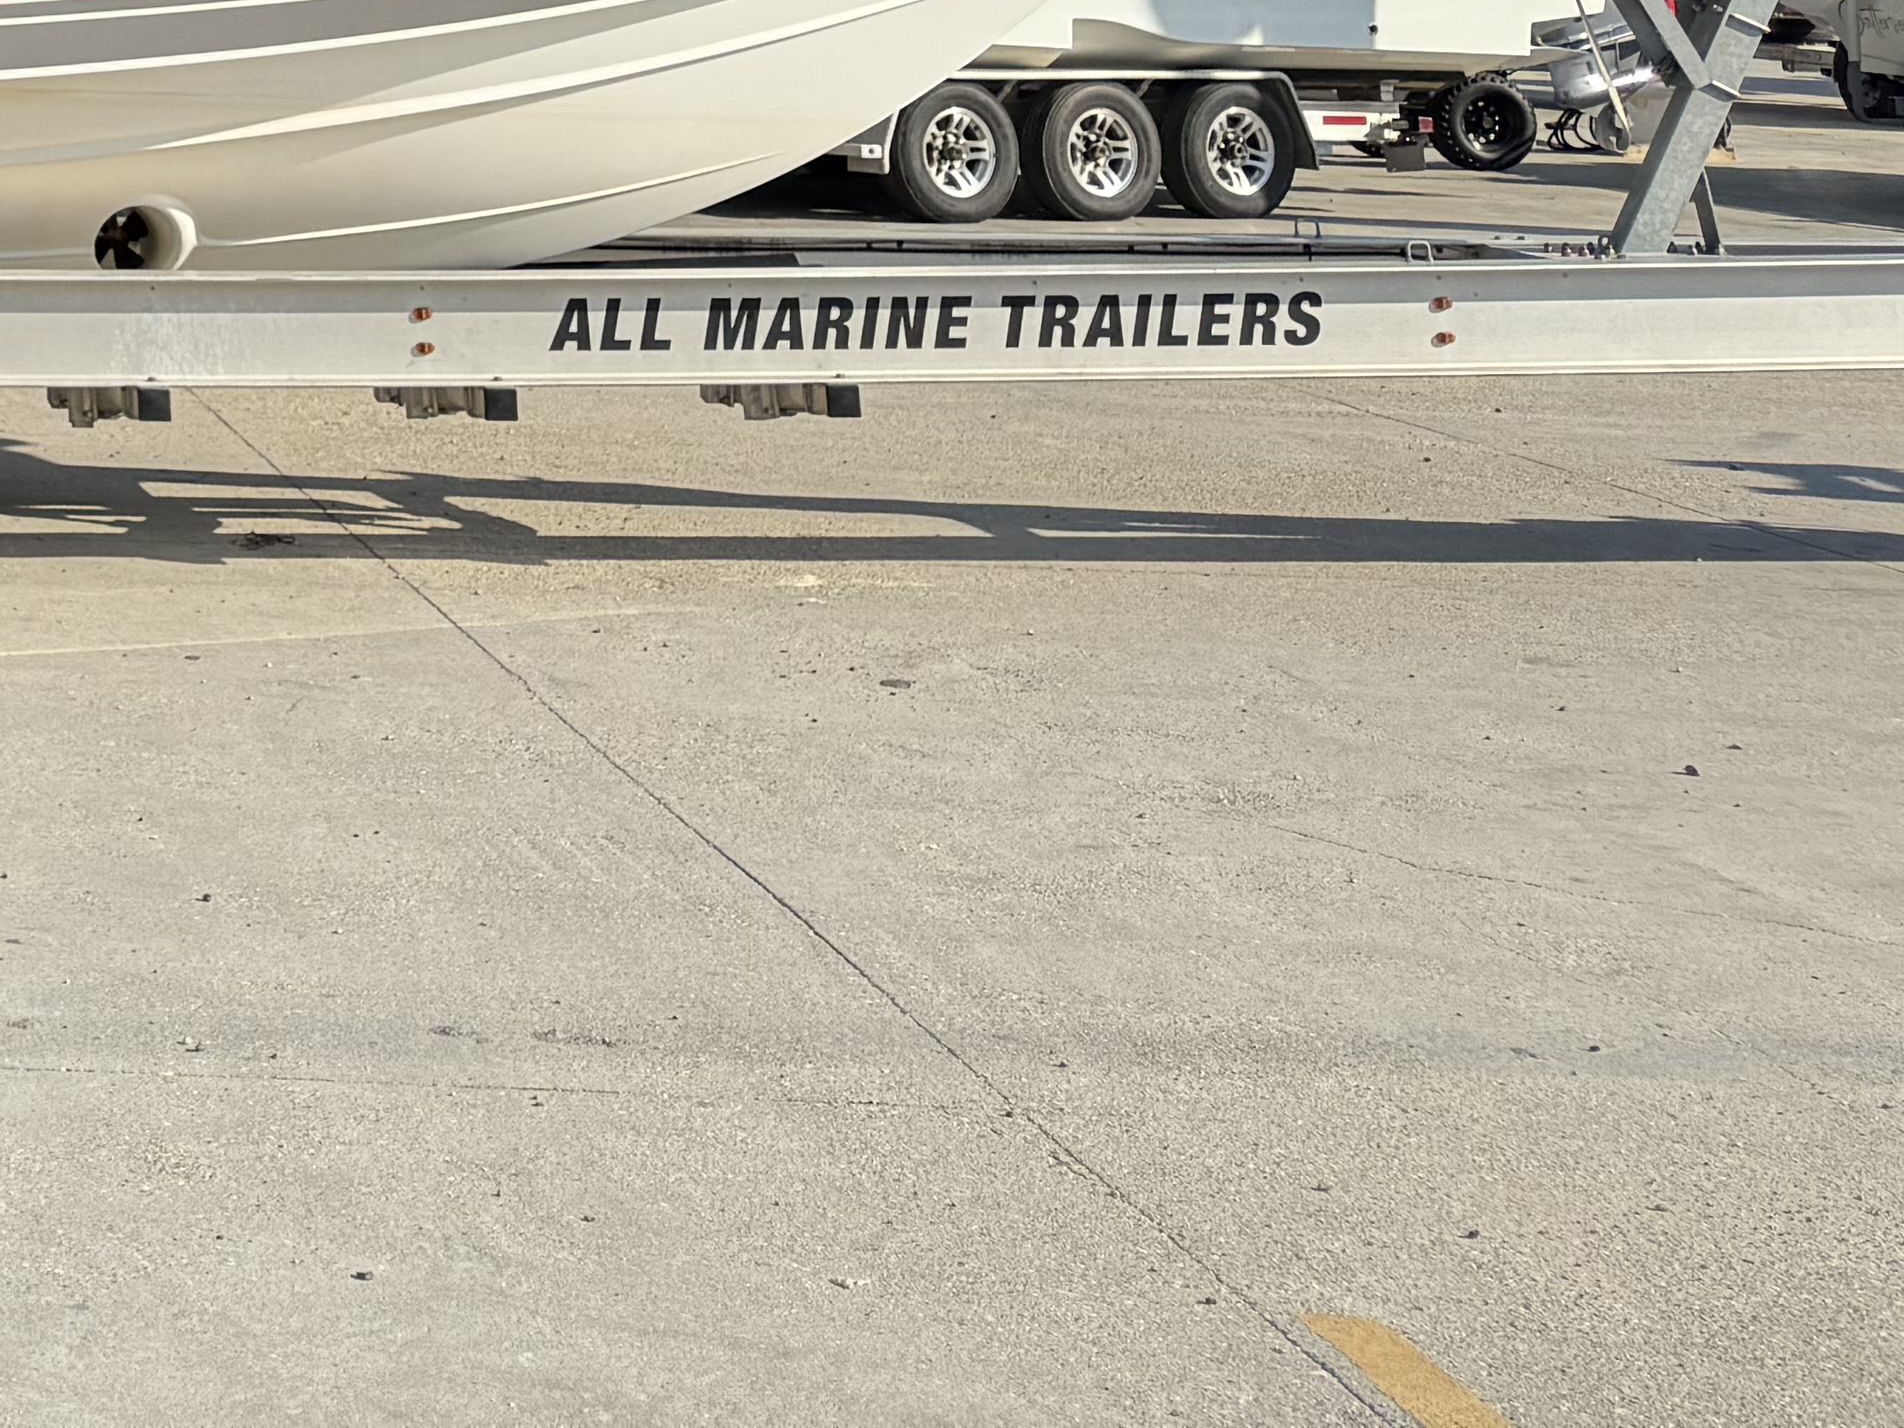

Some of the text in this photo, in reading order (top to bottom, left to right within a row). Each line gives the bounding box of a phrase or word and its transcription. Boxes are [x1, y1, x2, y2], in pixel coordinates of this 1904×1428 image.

[548, 290, 1325, 352] ALL MARINE TRAILERS
